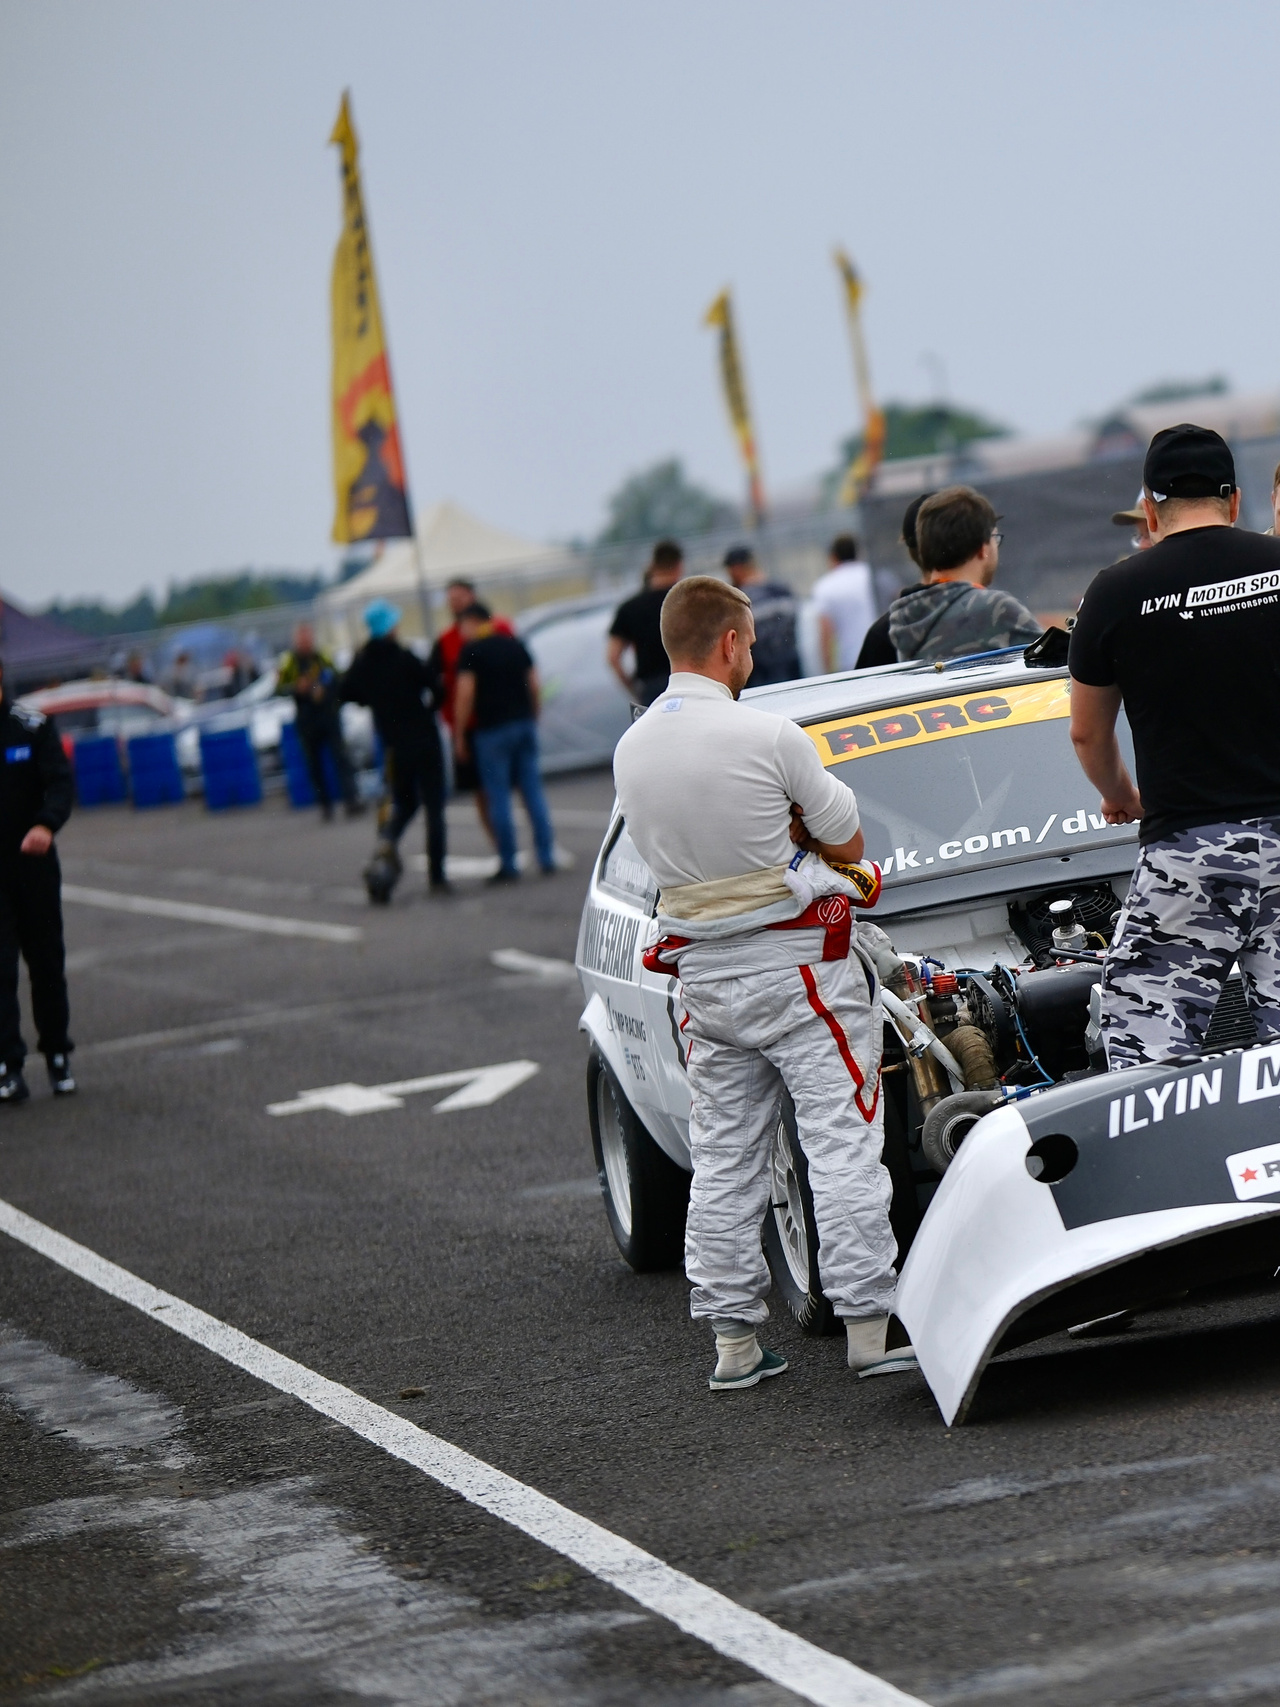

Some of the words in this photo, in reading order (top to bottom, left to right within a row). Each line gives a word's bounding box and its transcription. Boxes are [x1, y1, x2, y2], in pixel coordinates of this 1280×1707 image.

[1140, 592, 1181, 616] ILYIN
[1190, 580, 1247, 605] MOTOR
[1200, 594, 1279, 618] ILYINMOTORSPORT
[821, 695, 1012, 756] RDRC
[1108, 1068, 1224, 1139] ILYIN
